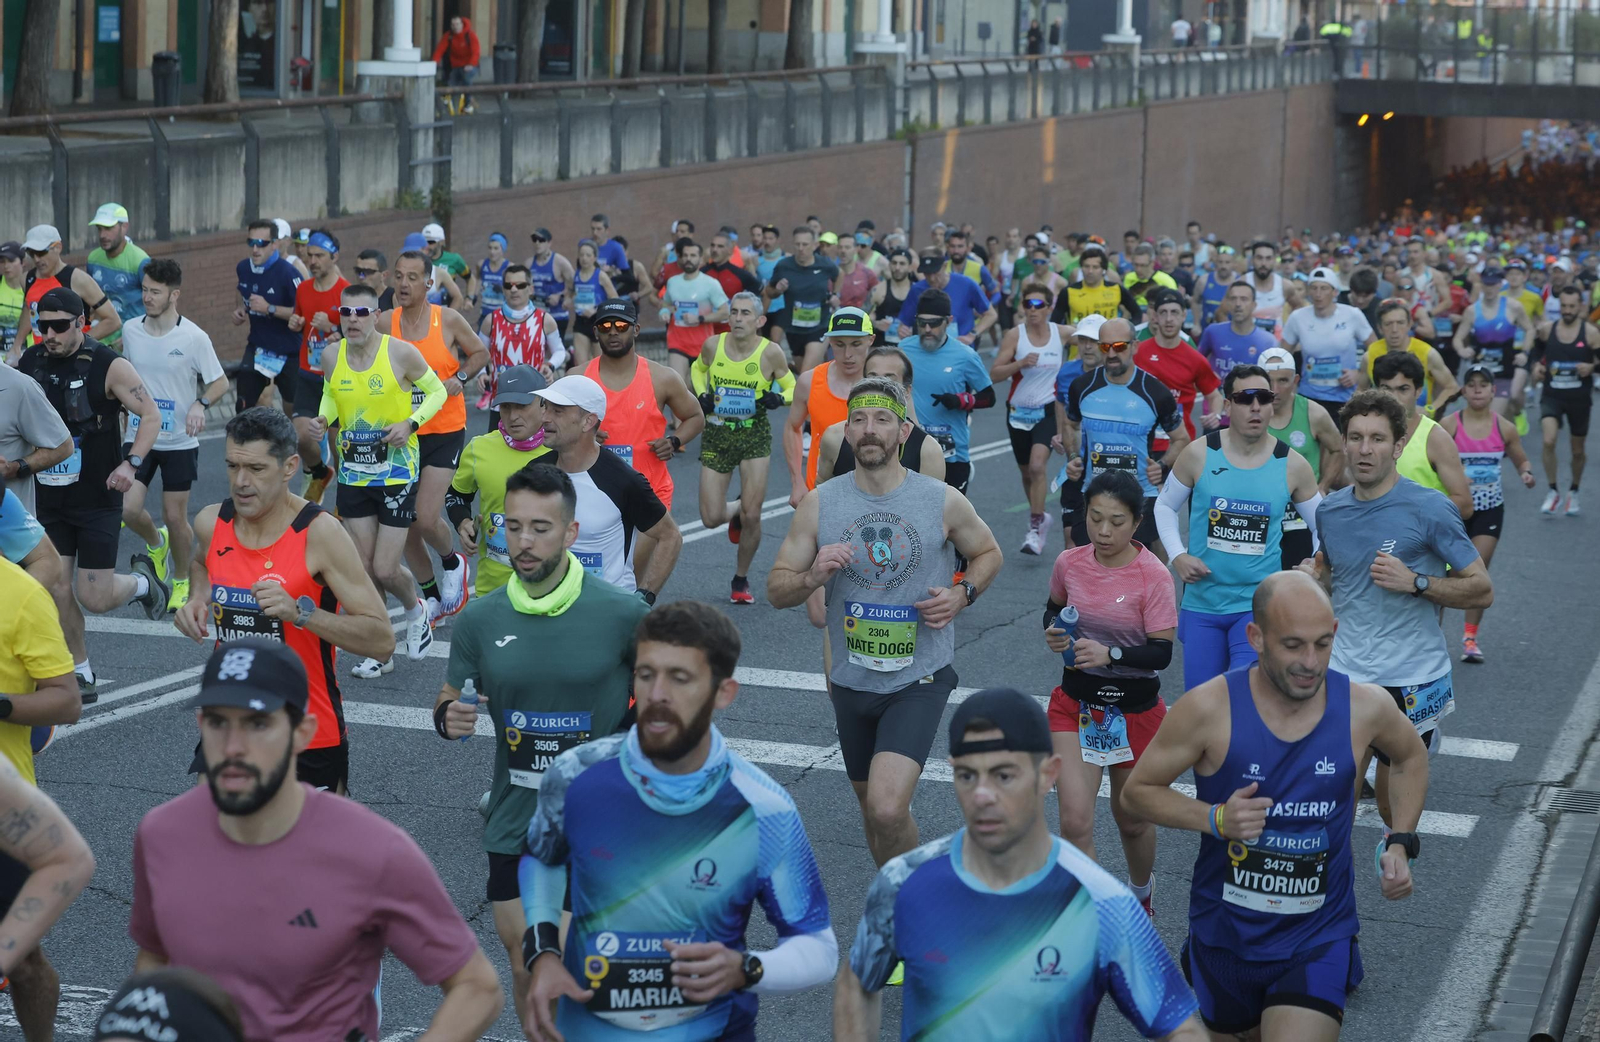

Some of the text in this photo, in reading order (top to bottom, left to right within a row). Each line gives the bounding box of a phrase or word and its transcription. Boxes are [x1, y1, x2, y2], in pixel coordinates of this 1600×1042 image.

[728, 389, 751, 397] ZURICH
[718, 407, 751, 415] PAQUITO
[355, 432, 382, 440] ZURICH
[354, 453, 377, 463] DADA
[1230, 502, 1265, 513] ZURICH
[855, 512, 901, 529] RUNNING
[1229, 517, 1248, 527] 3679
[1212, 525, 1262, 542] SUSARTE
[885, 523, 922, 591] CHEERLEADERS
[867, 608, 909, 618] ZURICH
[233, 614, 255, 627] 3983
[868, 628, 890, 638] 2304
[847, 636, 914, 656] NATE DOGG
[531, 717, 580, 728] ZURICH
[534, 740, 559, 752] 3505
[1265, 836, 1321, 850] ZURICH
[1263, 857, 1295, 873] 3475
[1233, 866, 1320, 895] VITORINO
[628, 968, 664, 984] 3345
[609, 986, 684, 1009] MARIA
